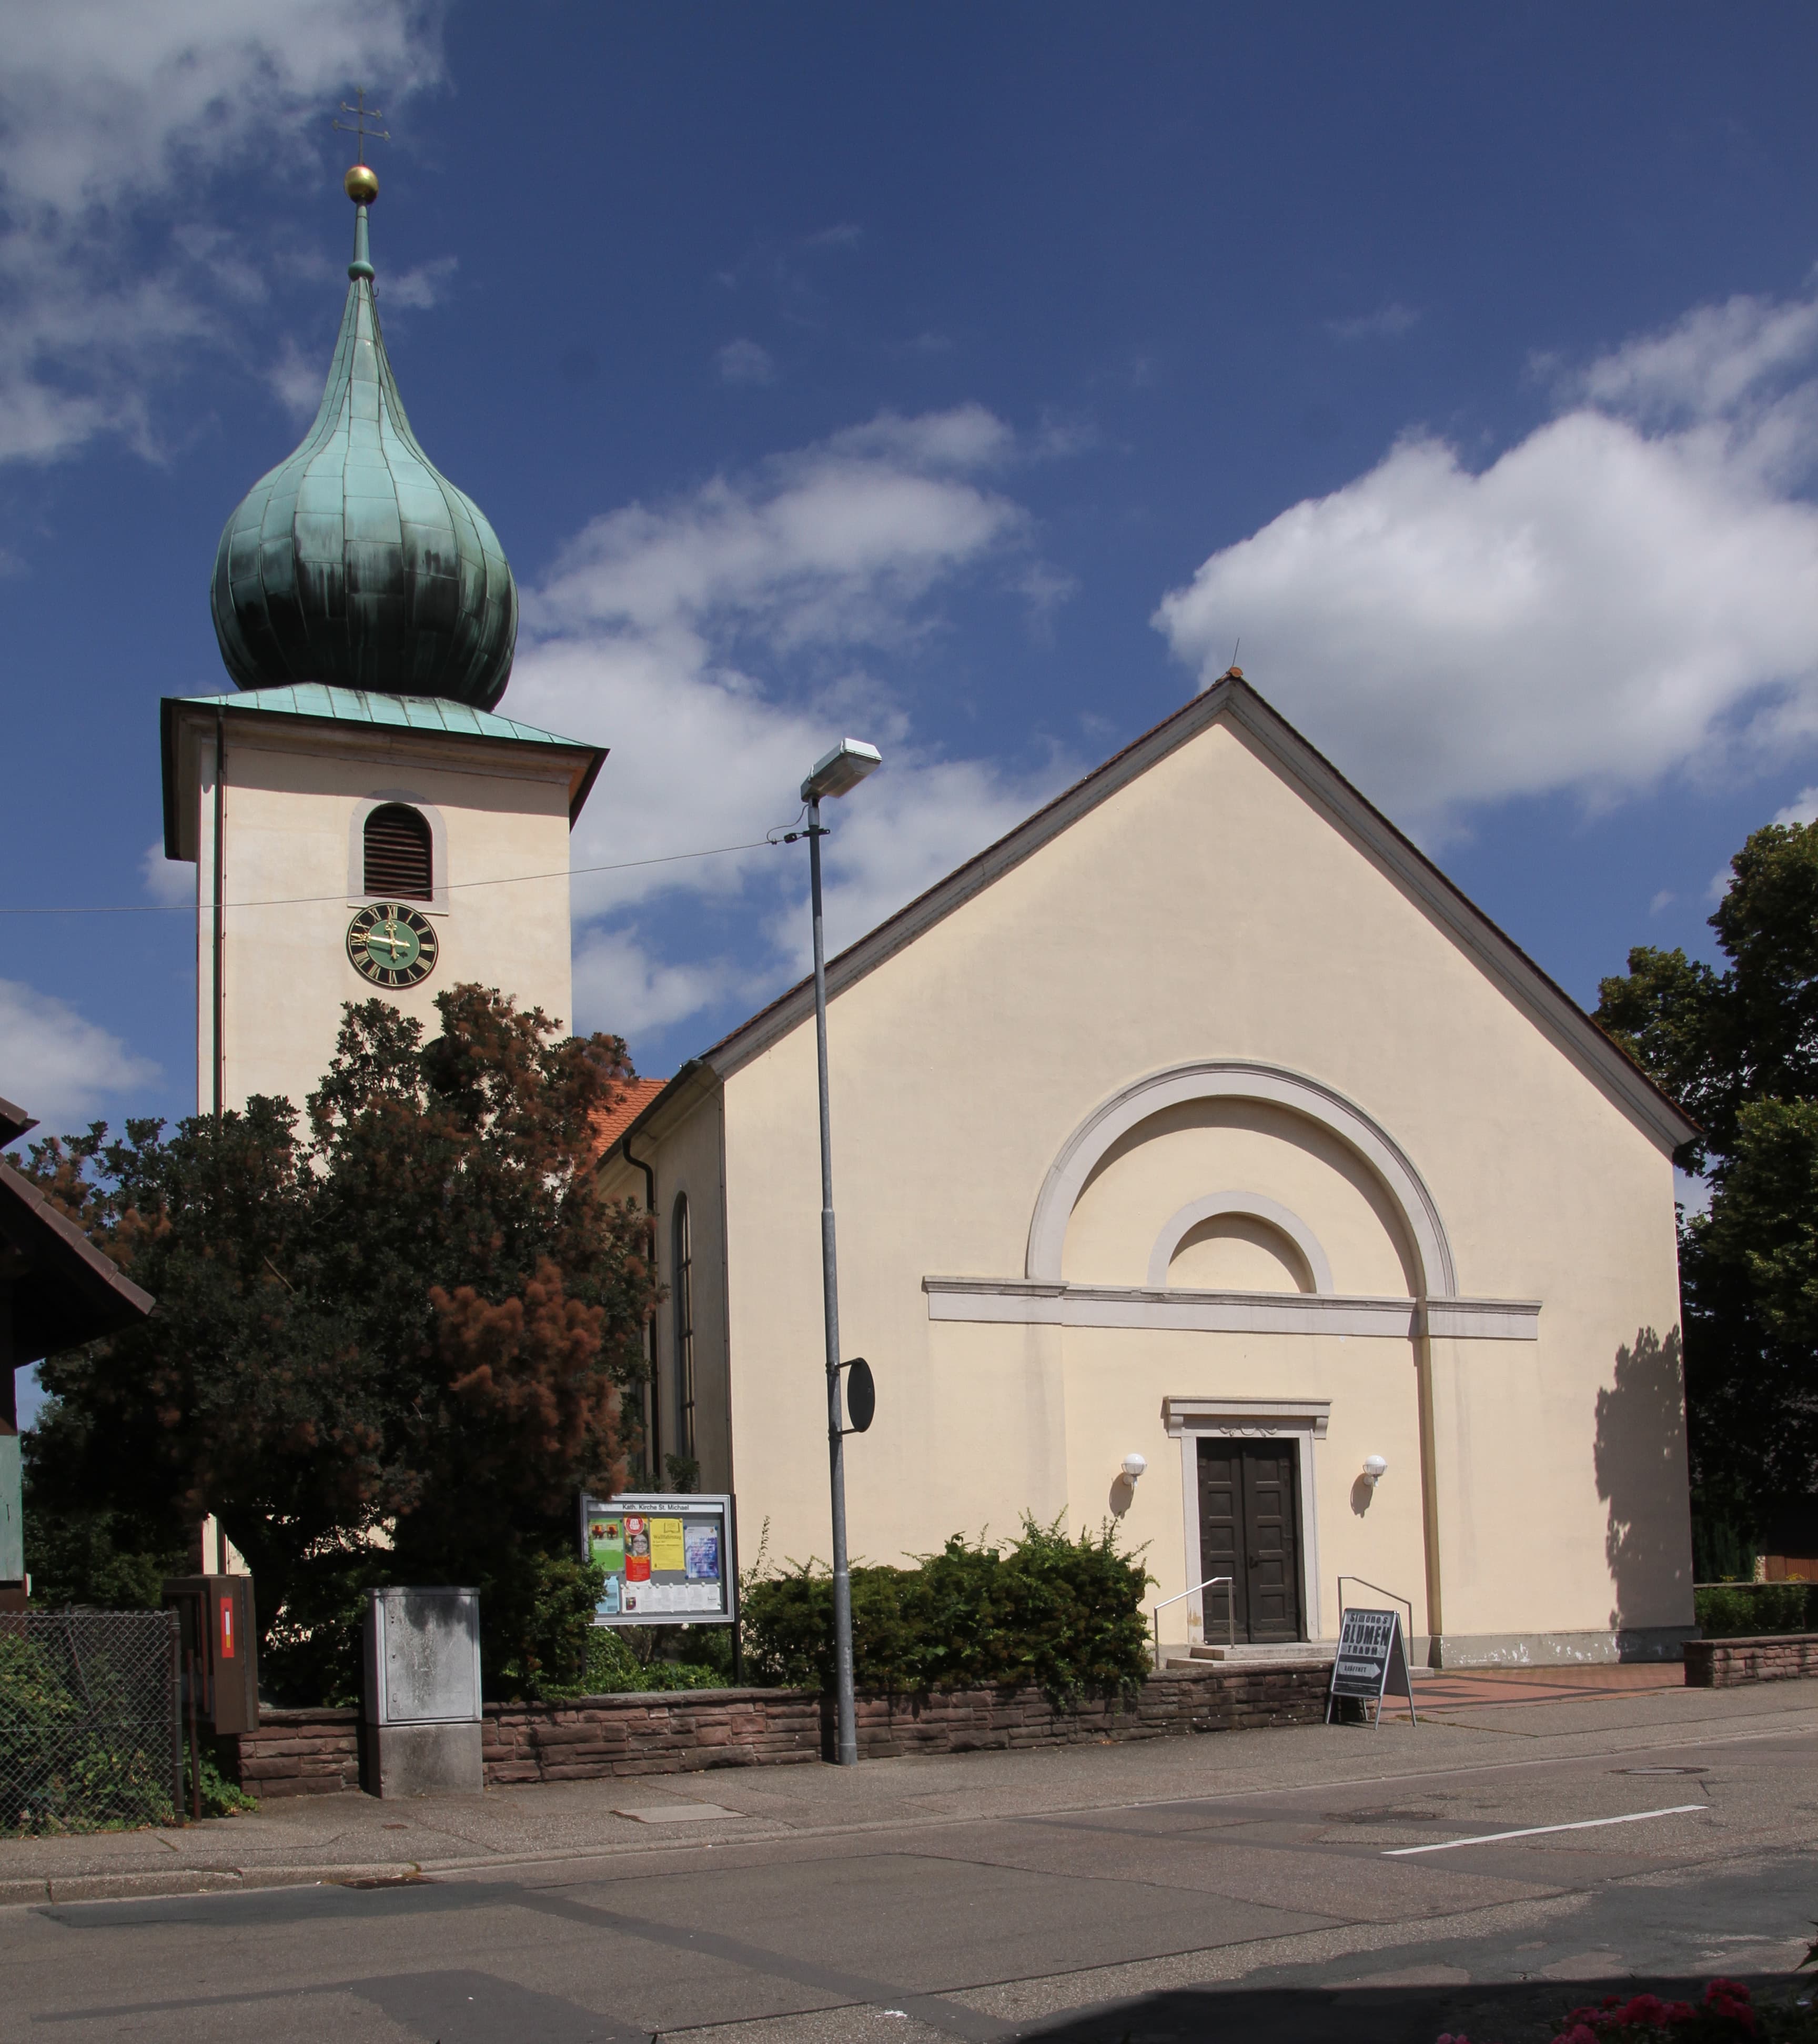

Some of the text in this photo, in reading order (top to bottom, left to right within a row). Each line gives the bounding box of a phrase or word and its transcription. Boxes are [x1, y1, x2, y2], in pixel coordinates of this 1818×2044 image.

[368, 908, 381, 923] XI
[406, 912, 414, 923] I
[355, 920, 370, 932] X
[416, 927, 430, 935] II
[354, 951, 370, 967] VIII
[368, 963, 381, 980] VII
[389, 970, 398, 984] VI
[407, 968, 417, 982] V
[1350, 1613, 1388, 1624] Simone's
[1343, 1624, 1390, 1645] BLUMEN
[1347, 1645, 1378, 1656] TRAUM
